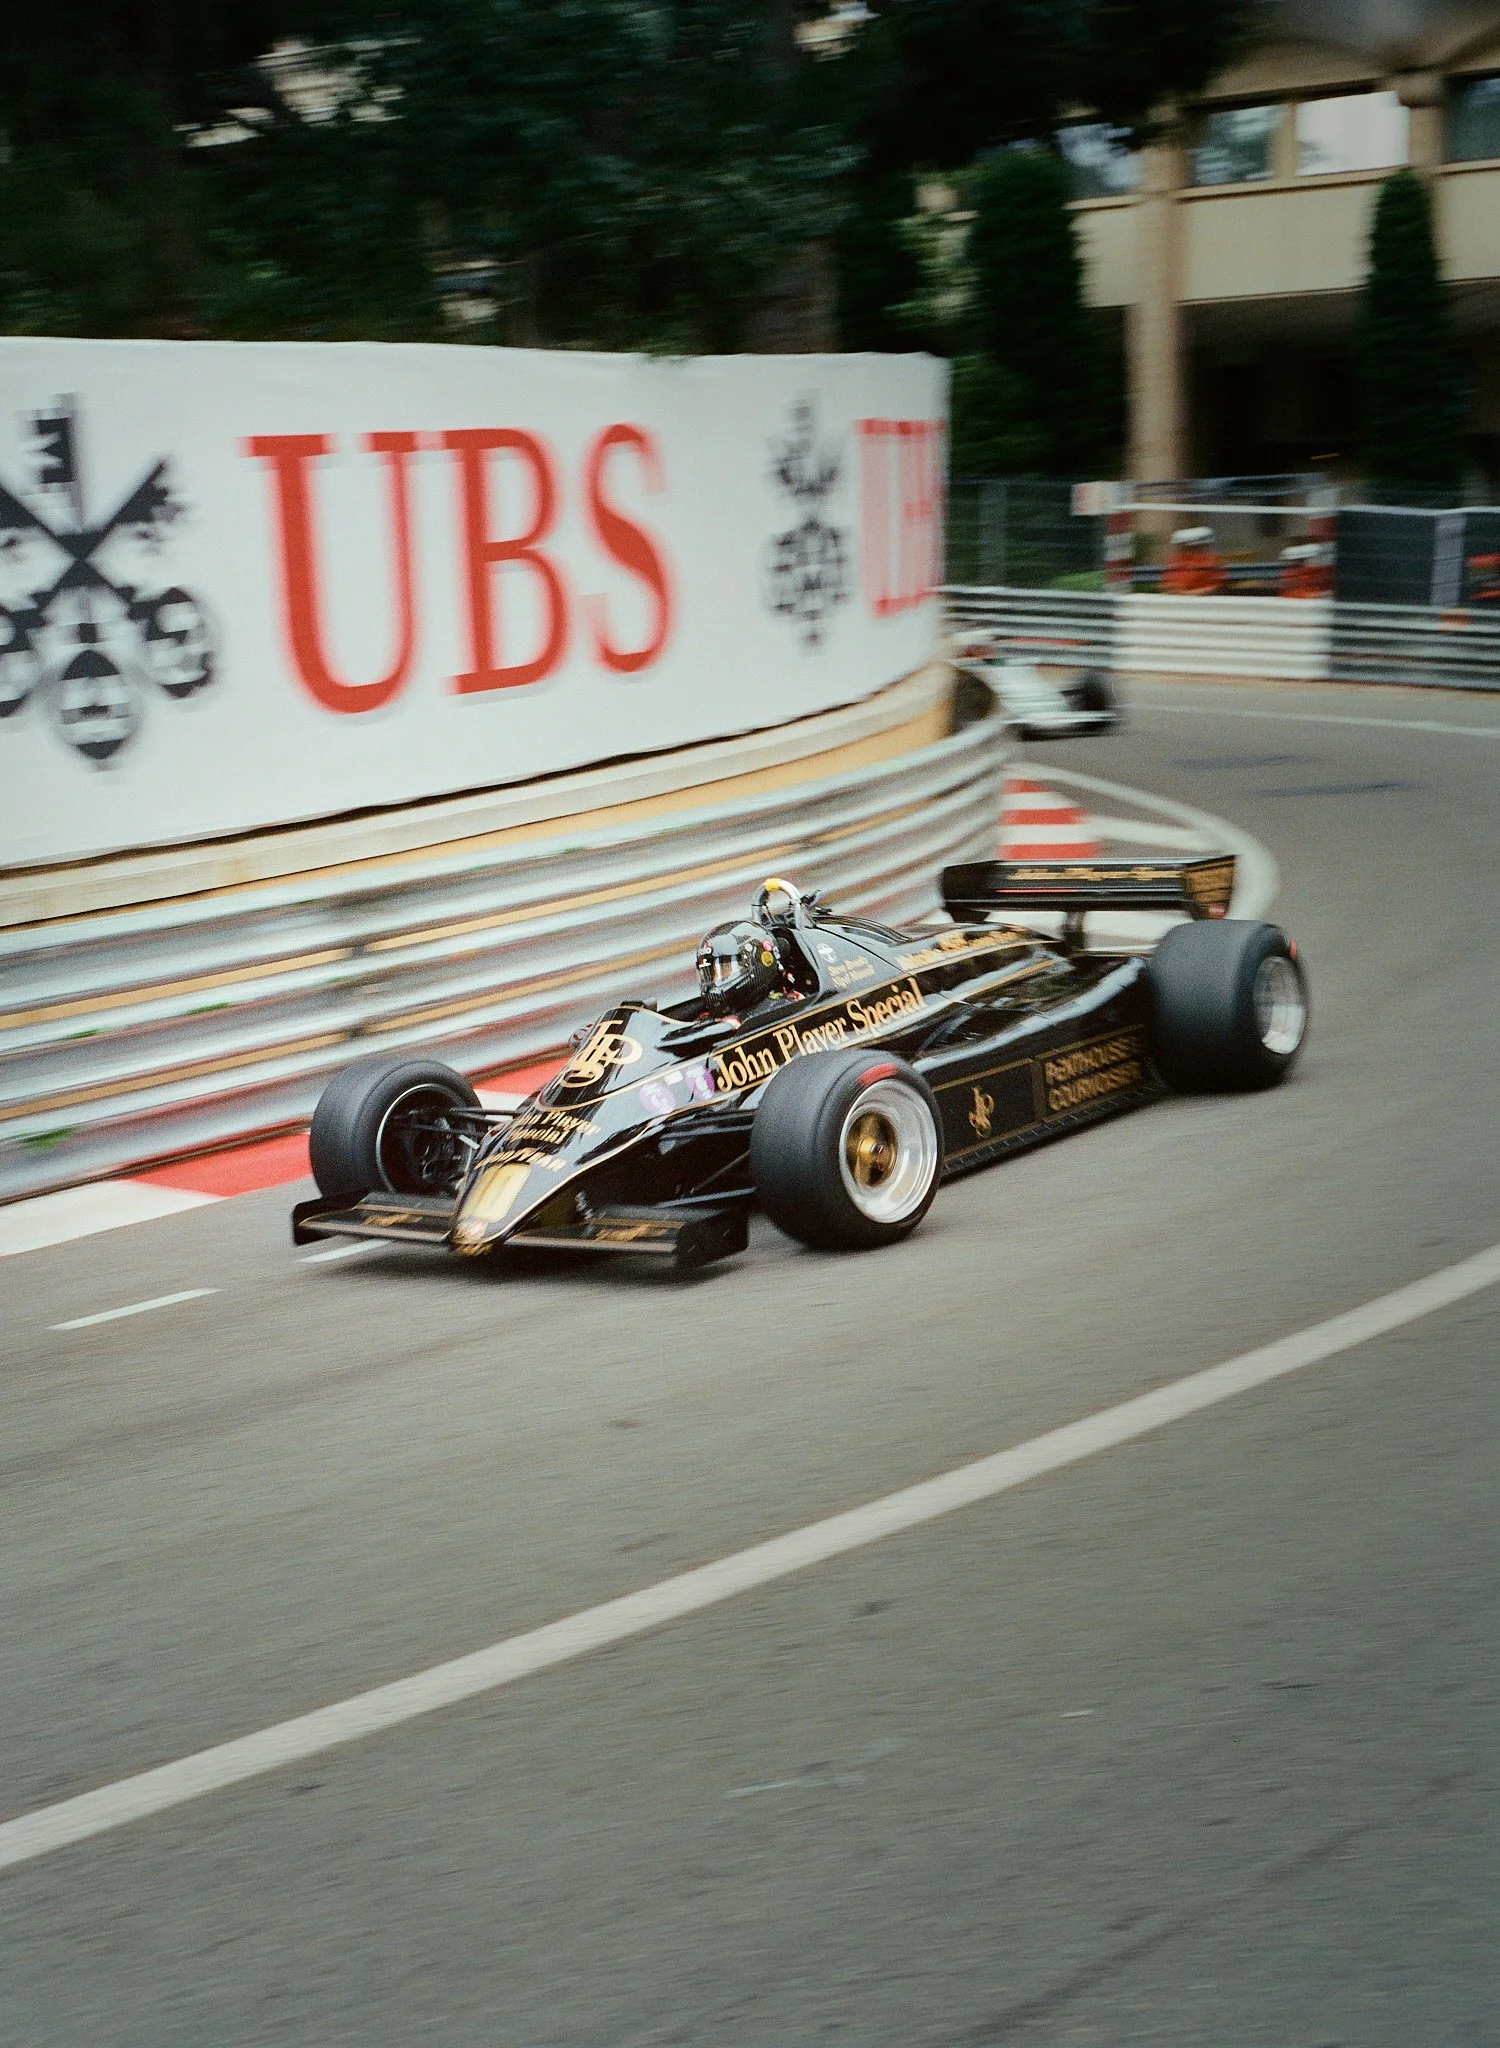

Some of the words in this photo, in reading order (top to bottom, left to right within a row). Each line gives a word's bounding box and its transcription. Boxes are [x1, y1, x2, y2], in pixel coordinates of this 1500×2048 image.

[238, 422, 673, 713] UBS
[714, 1046, 779, 1092] John
[773, 1018, 847, 1066] Player
[847, 976, 926, 1038] Special
